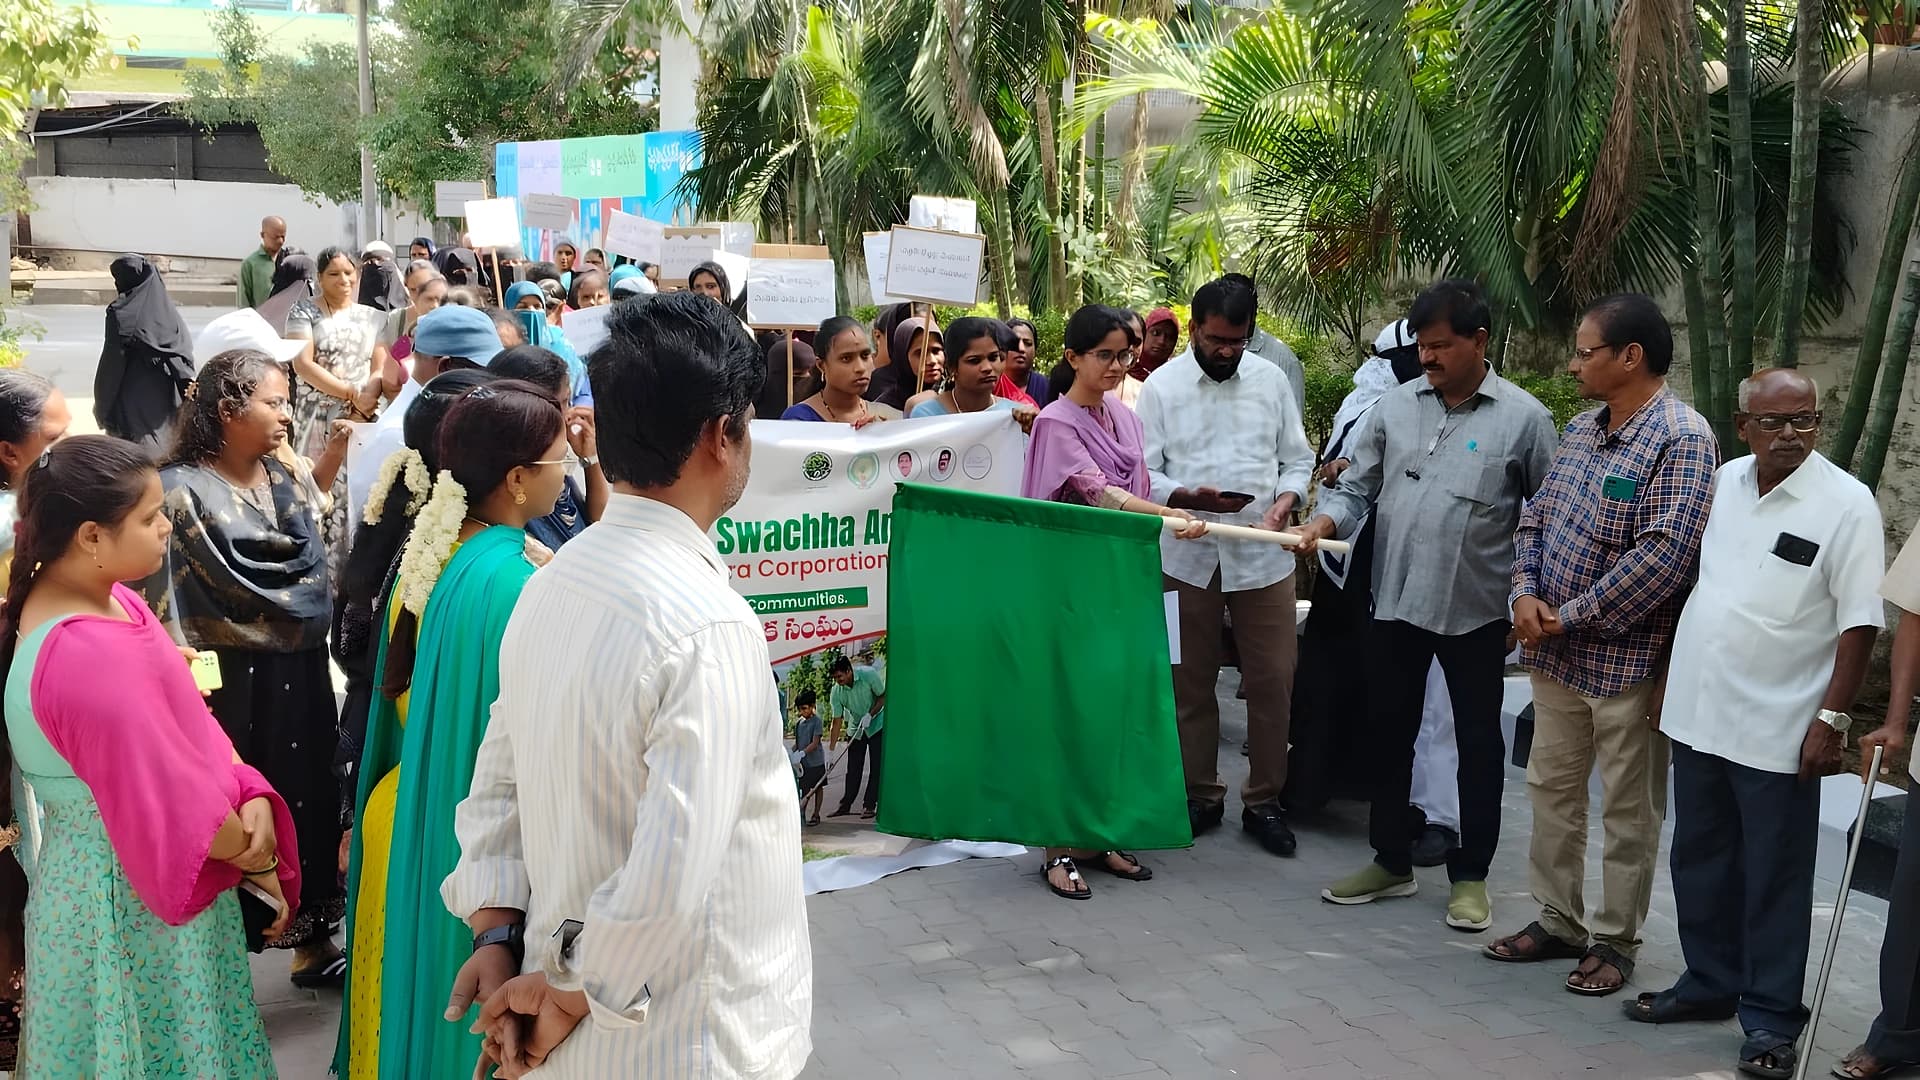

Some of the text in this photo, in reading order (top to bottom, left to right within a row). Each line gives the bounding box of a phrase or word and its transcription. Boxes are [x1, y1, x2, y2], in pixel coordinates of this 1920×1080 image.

[716, 511, 855, 555] Swachha
[758, 550, 888, 581] Corporation
[785, 615, 853, 641] సంఘం
